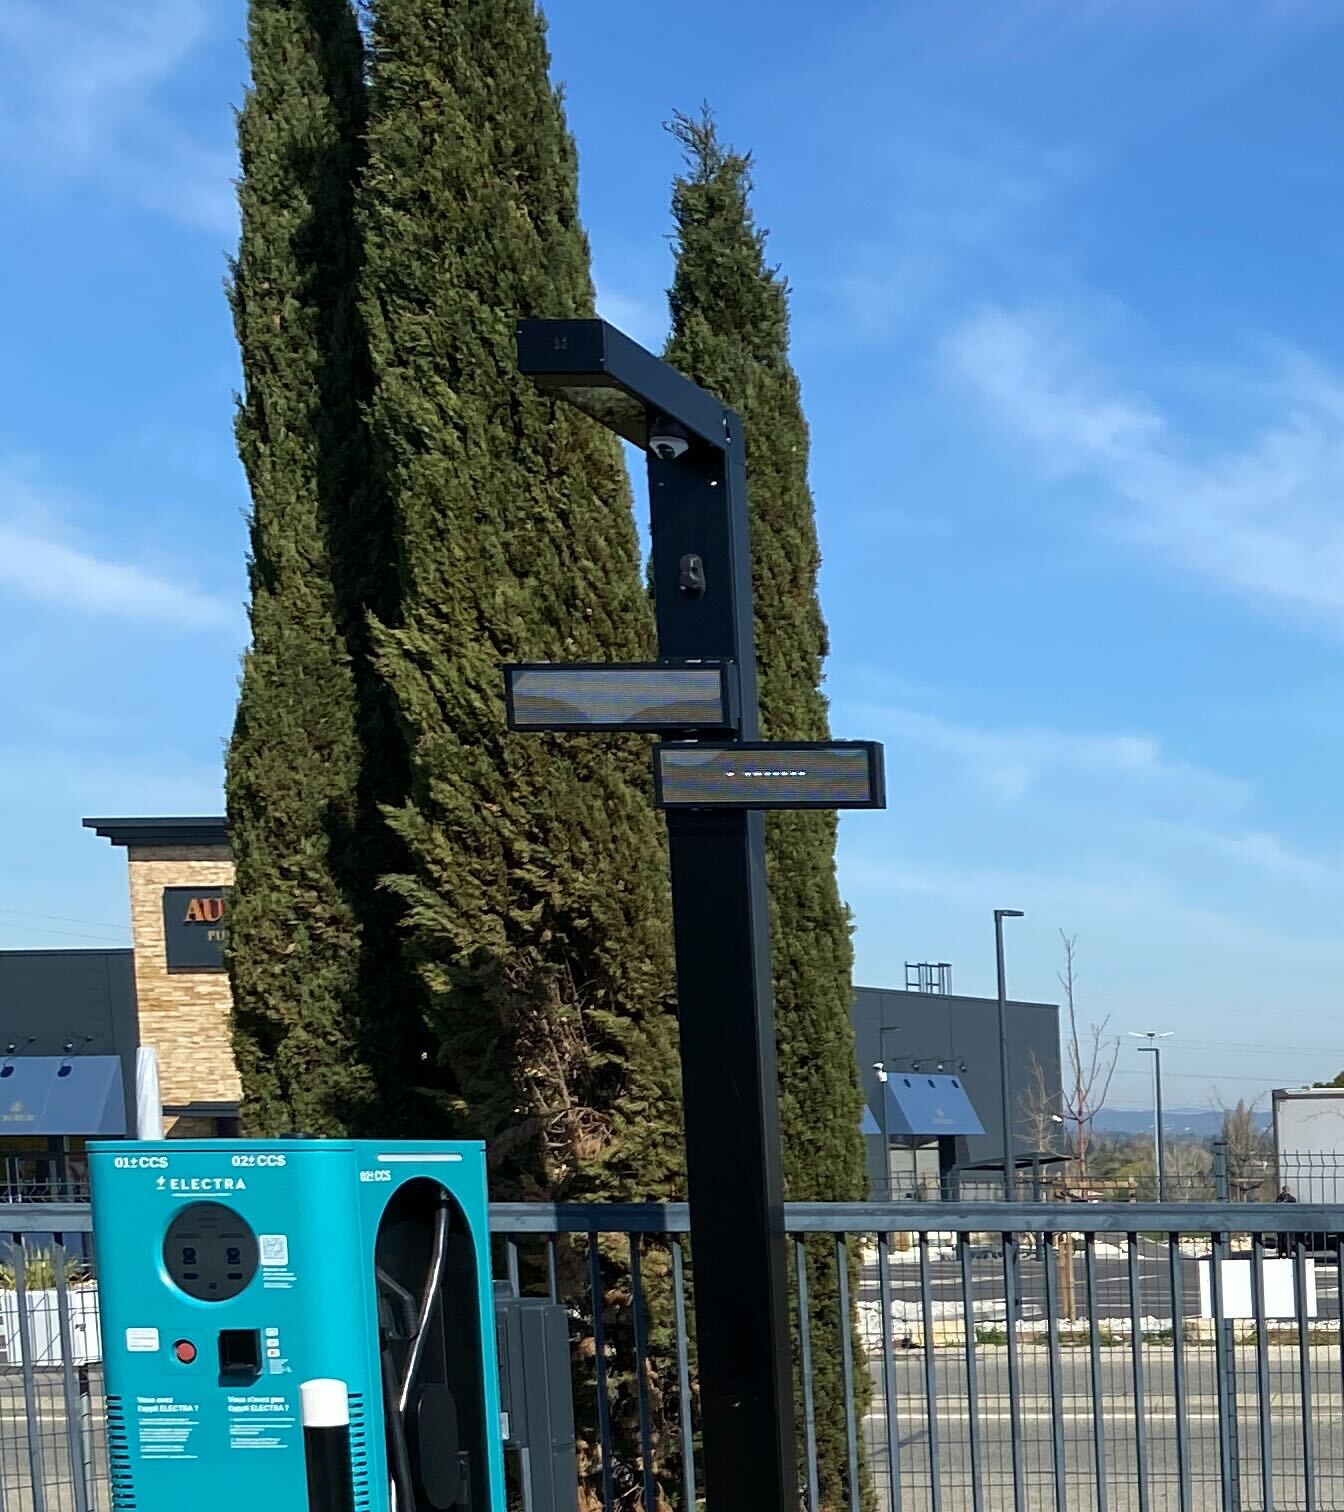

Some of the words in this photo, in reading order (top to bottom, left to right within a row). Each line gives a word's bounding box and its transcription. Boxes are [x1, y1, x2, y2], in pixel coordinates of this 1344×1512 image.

[139, 1156, 168, 1168] CCS
[256, 1155, 287, 1167] CCS
[170, 1178, 247, 1190] ELECTRA
